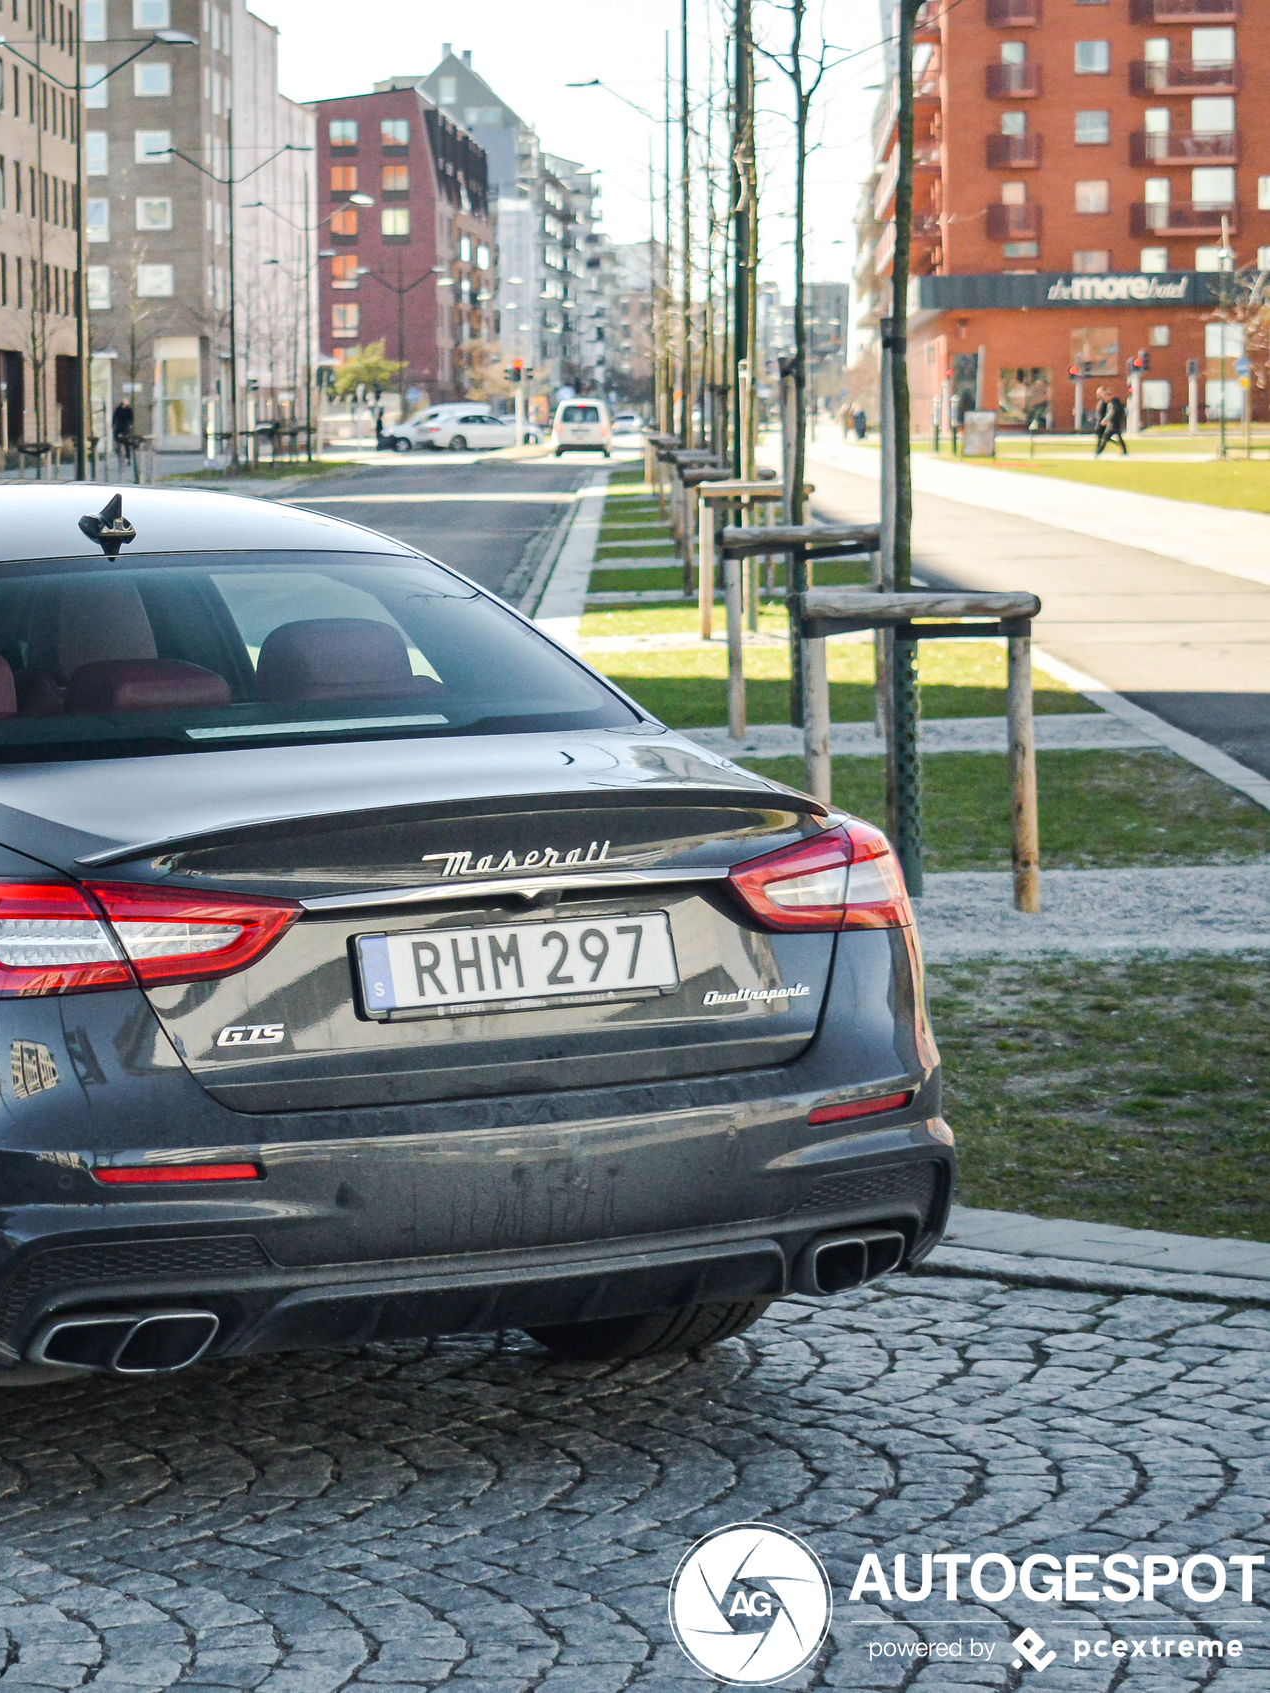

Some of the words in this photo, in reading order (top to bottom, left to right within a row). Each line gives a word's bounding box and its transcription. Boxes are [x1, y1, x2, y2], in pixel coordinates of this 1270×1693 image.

[422, 840, 628, 877] Maserati
[411, 933, 524, 997] RHM
[541, 924, 644, 986] 297
[373, 981, 386, 998] S
[702, 983, 810, 1006] Quattroporte
[216, 1023, 285, 1047] GTS
